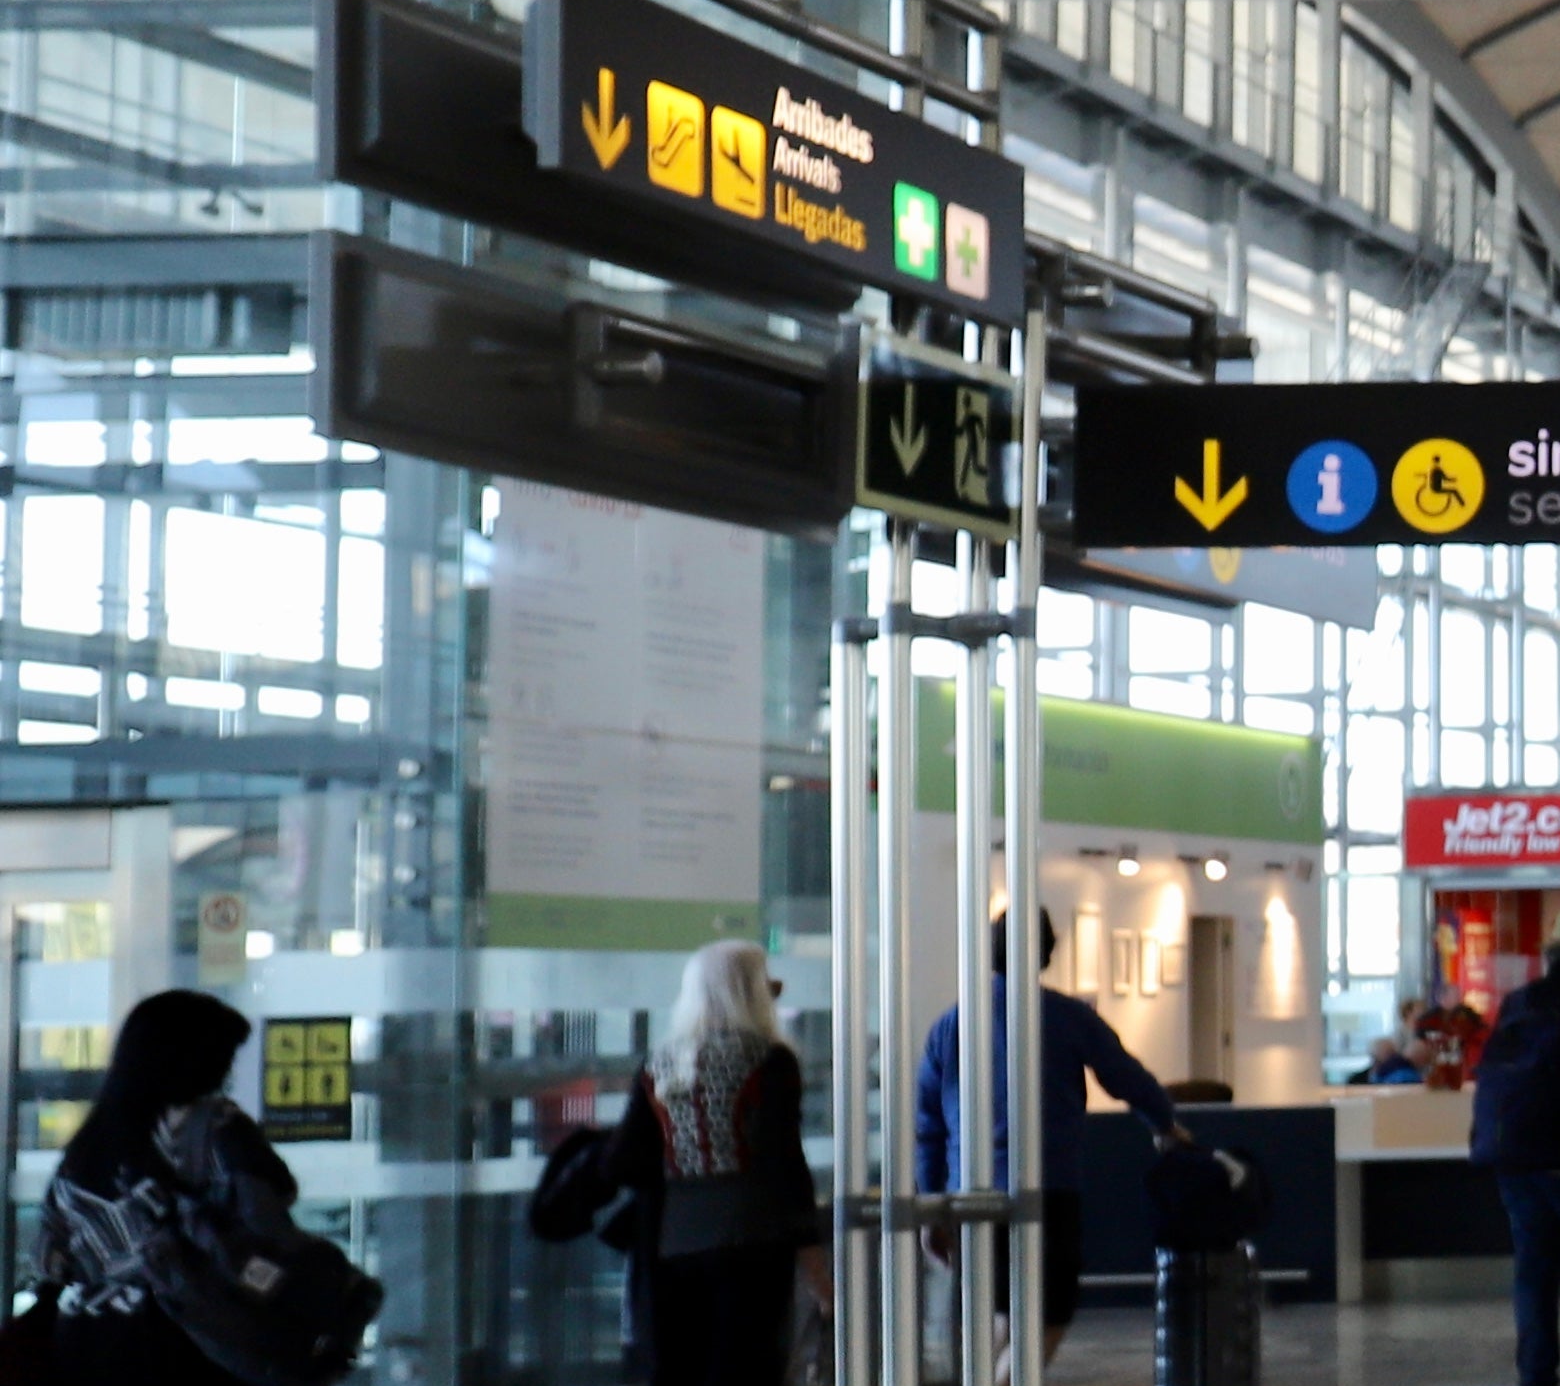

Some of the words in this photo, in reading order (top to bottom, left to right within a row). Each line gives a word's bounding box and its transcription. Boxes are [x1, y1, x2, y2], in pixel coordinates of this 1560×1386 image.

[772, 85, 875, 163] Arribades
[772, 134, 843, 195] Arrivals
[774, 180, 868, 253] Llegadas
